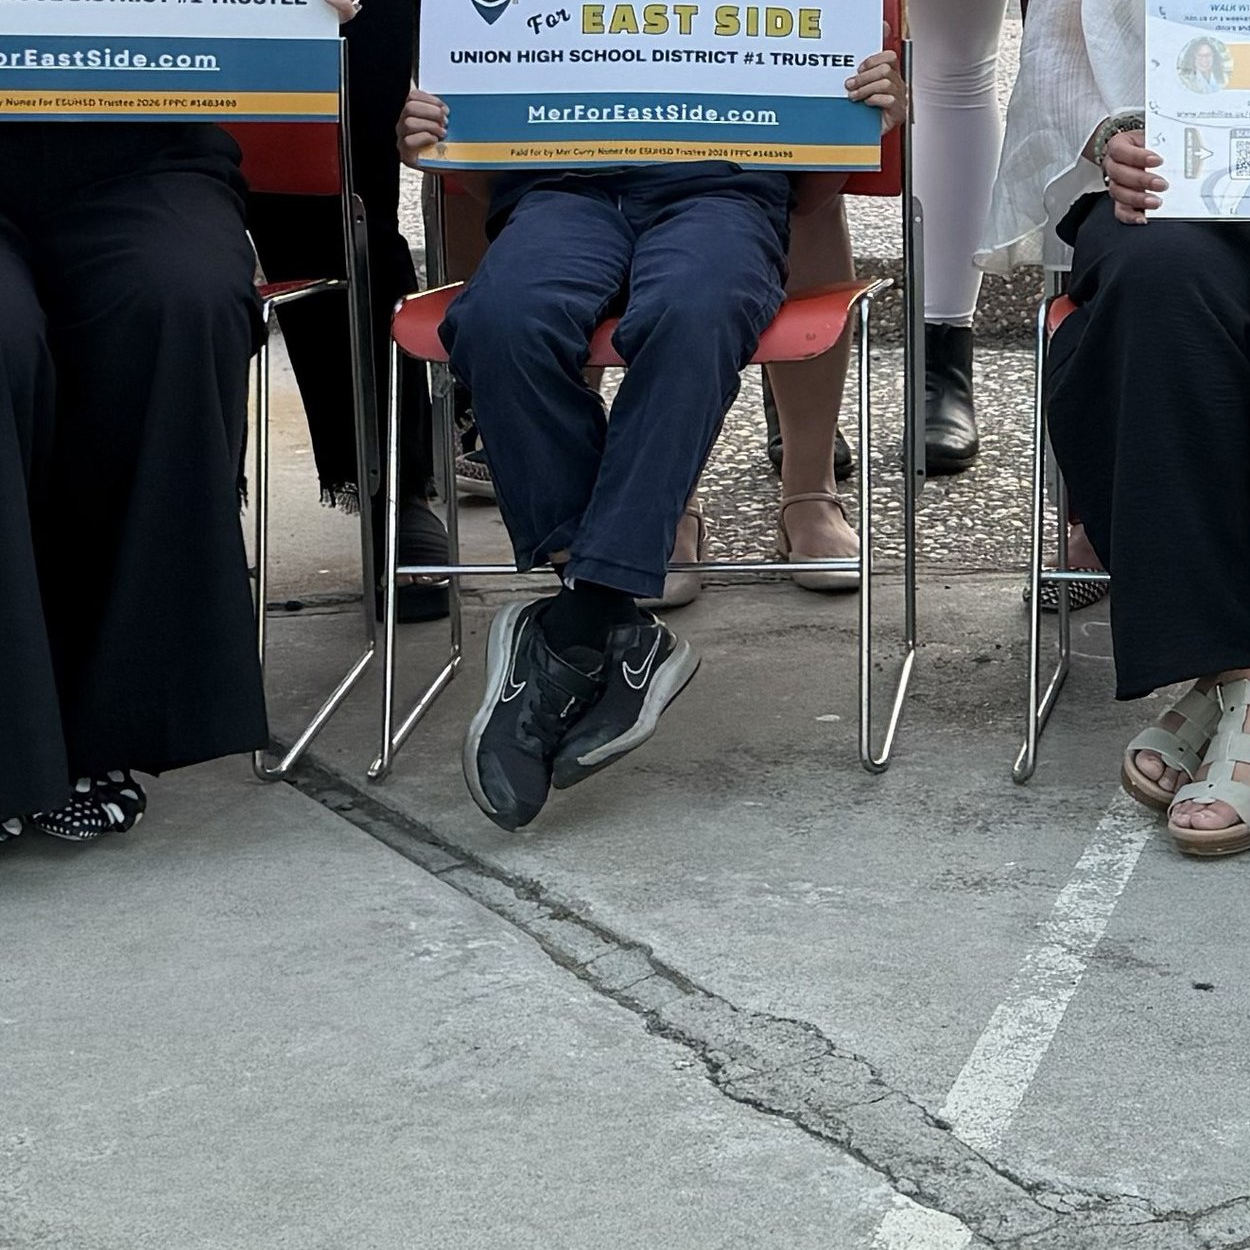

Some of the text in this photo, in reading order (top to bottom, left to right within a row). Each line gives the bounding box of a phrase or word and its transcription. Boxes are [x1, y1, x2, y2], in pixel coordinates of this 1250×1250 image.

[527, 5, 822, 39] For EAST SIDE
[450, 50, 854, 66] UNION HIGH SCHOOL DISTRICT #1 TRUSTEE
[528, 105, 778, 125] MerForEastSide.com
